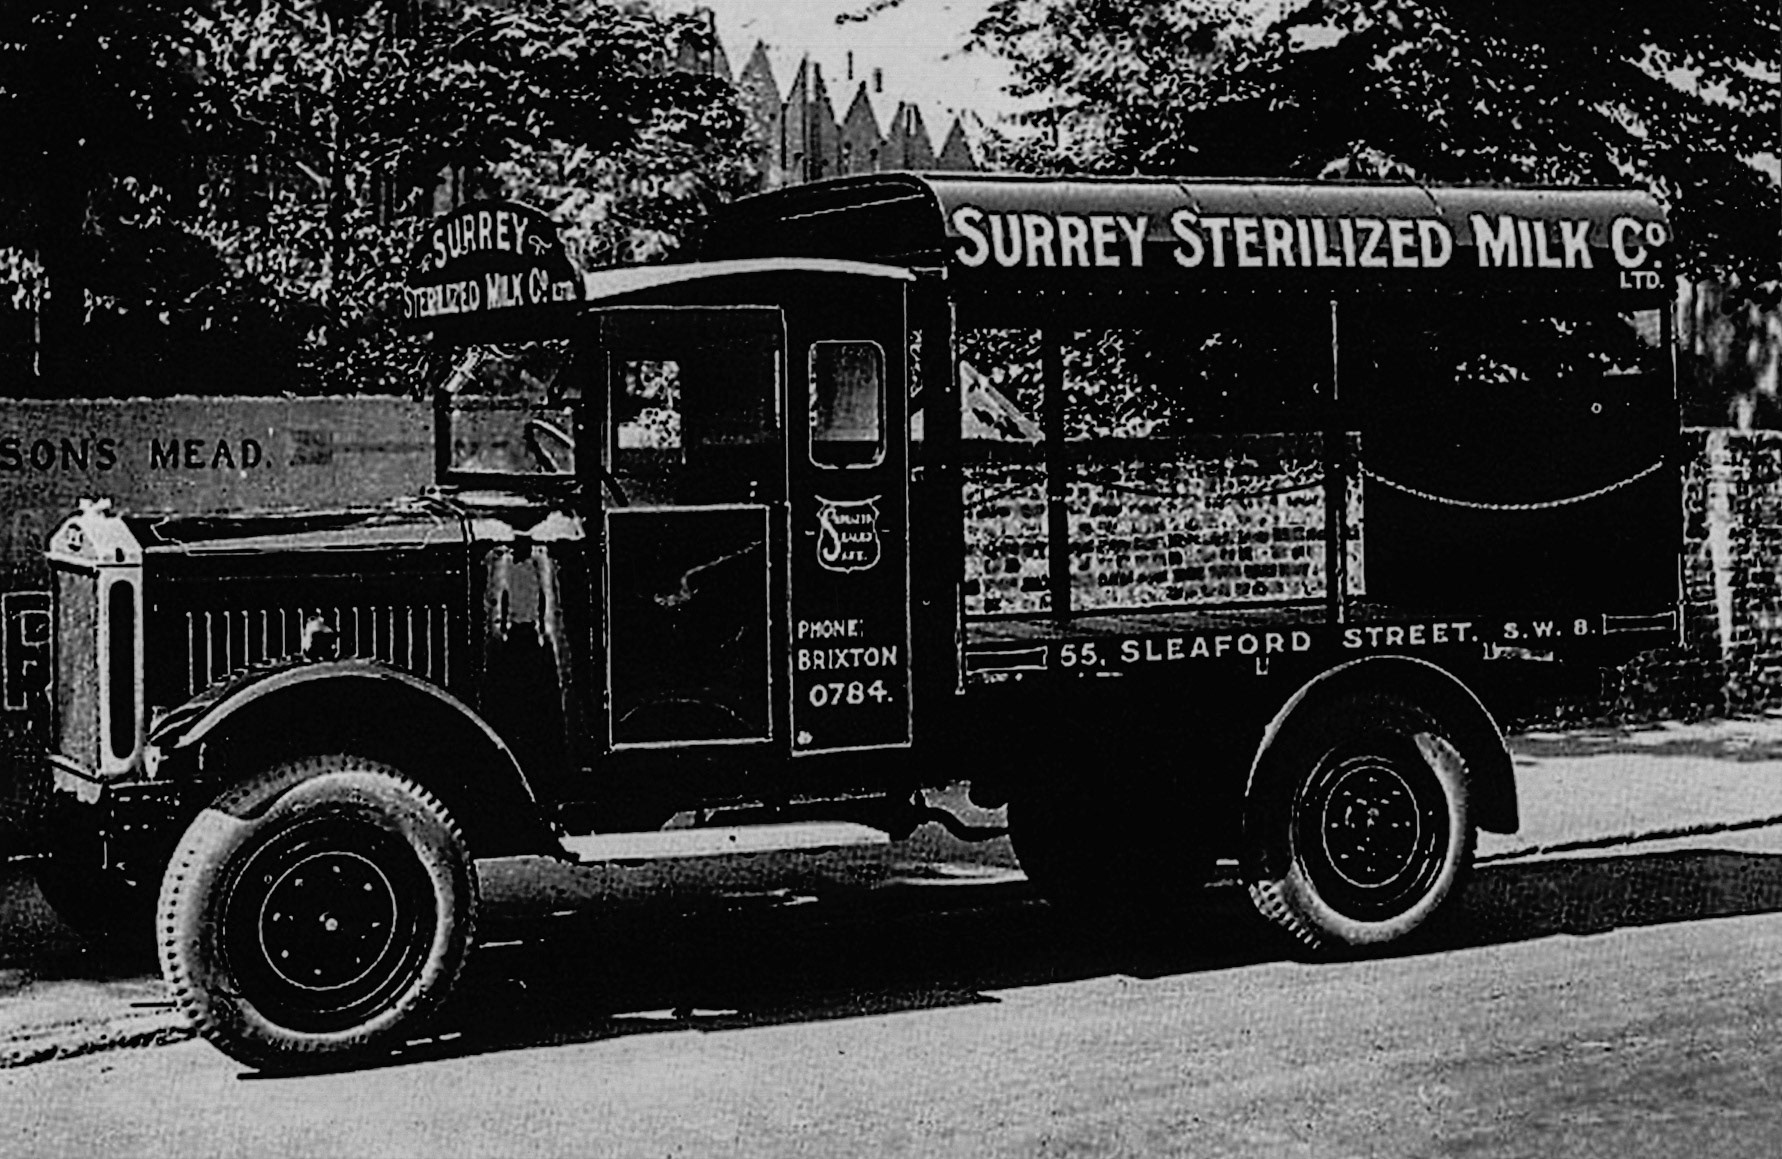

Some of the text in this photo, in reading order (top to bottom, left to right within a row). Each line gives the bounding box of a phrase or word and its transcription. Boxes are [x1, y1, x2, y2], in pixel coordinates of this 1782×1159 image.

[432, 210, 528, 269] SURREY
[952, 206, 1148, 268] SURREY
[1171, 209, 1452, 268] STERILIZED
[1470, 214, 1594, 269] MILK
[150, 438, 272, 470] MEAD.
[798, 645, 898, 671] BRIXTON
[1120, 631, 1312, 663] SLEAFORD
[1342, 622, 1479, 649] STREET.
[809, 679, 894, 708] 0784.
